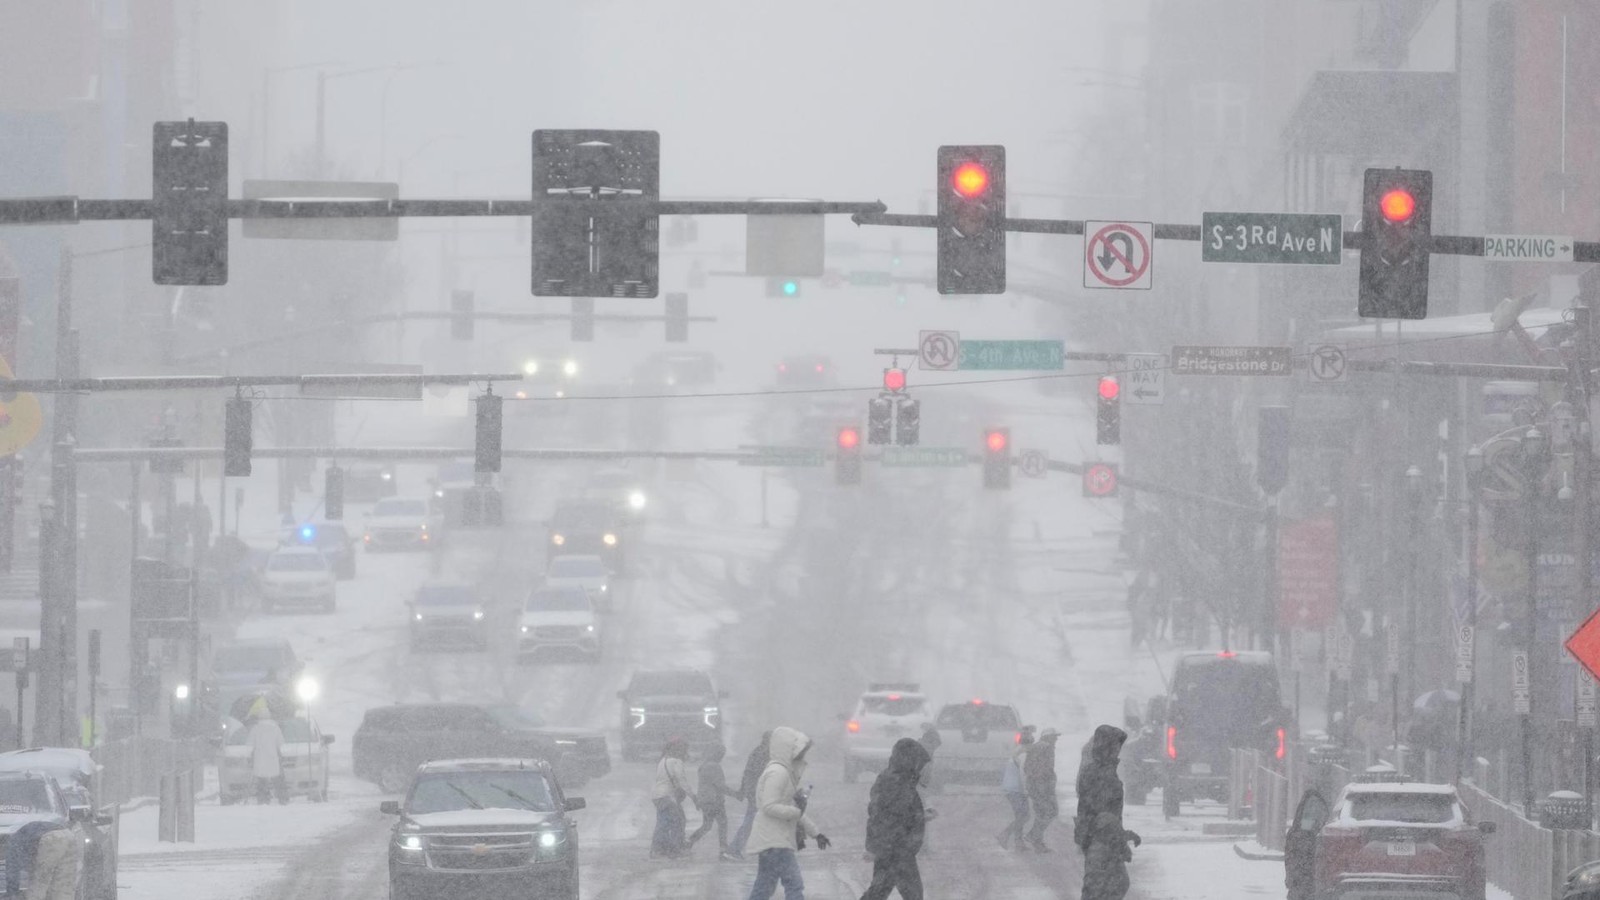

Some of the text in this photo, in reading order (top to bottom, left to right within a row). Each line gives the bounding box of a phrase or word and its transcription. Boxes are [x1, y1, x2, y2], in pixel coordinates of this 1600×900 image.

[1281, 231, 1316, 252] Ave
[1320, 227, 1332, 253] N
[1485, 237, 1555, 258] PARKING
[1133, 358, 1158, 370] ONE
[1178, 357, 1285, 374] Bridgestone Dr
[1132, 372, 1159, 384] WAY
